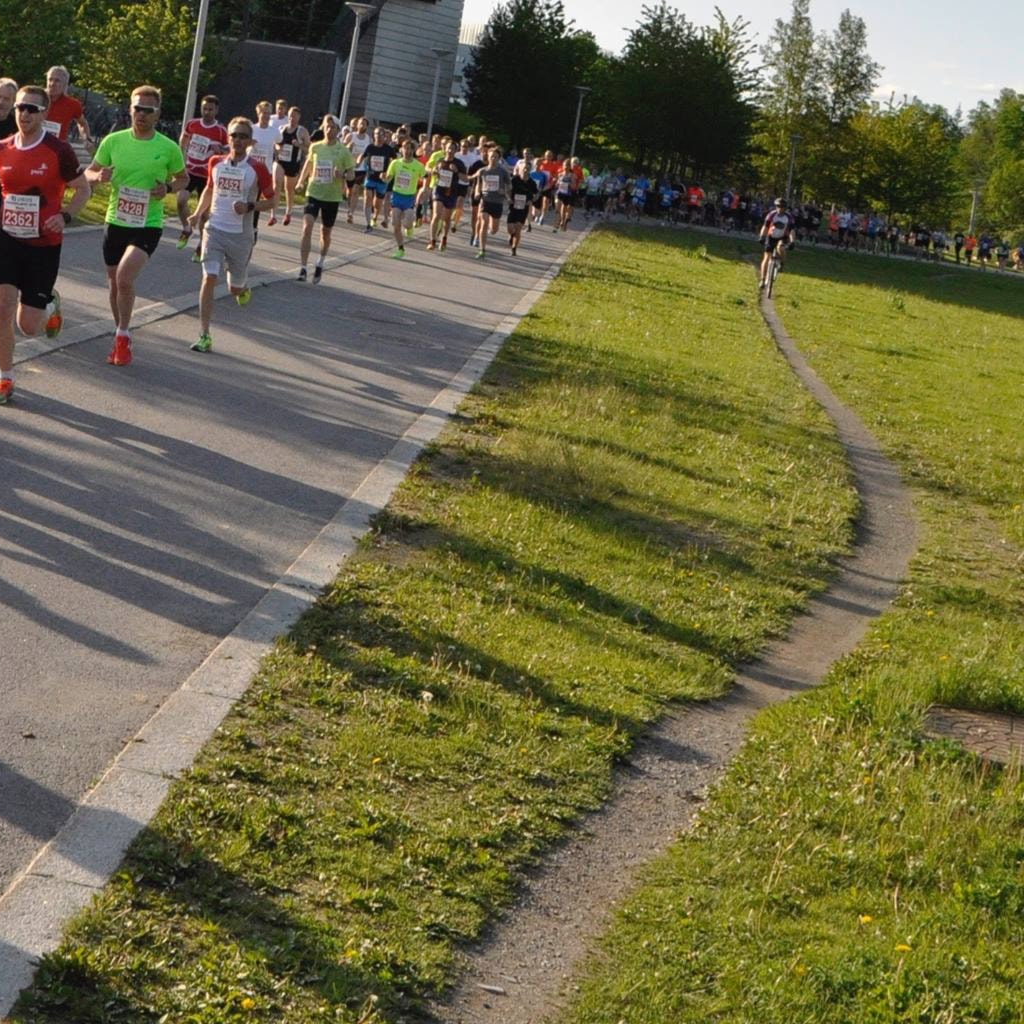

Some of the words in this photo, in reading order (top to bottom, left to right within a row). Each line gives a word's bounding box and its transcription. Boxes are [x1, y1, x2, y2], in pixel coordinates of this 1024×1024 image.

[218, 178, 240, 190] 2452
[118, 199, 143, 216] 2428
[4, 211, 33, 227] 2362
